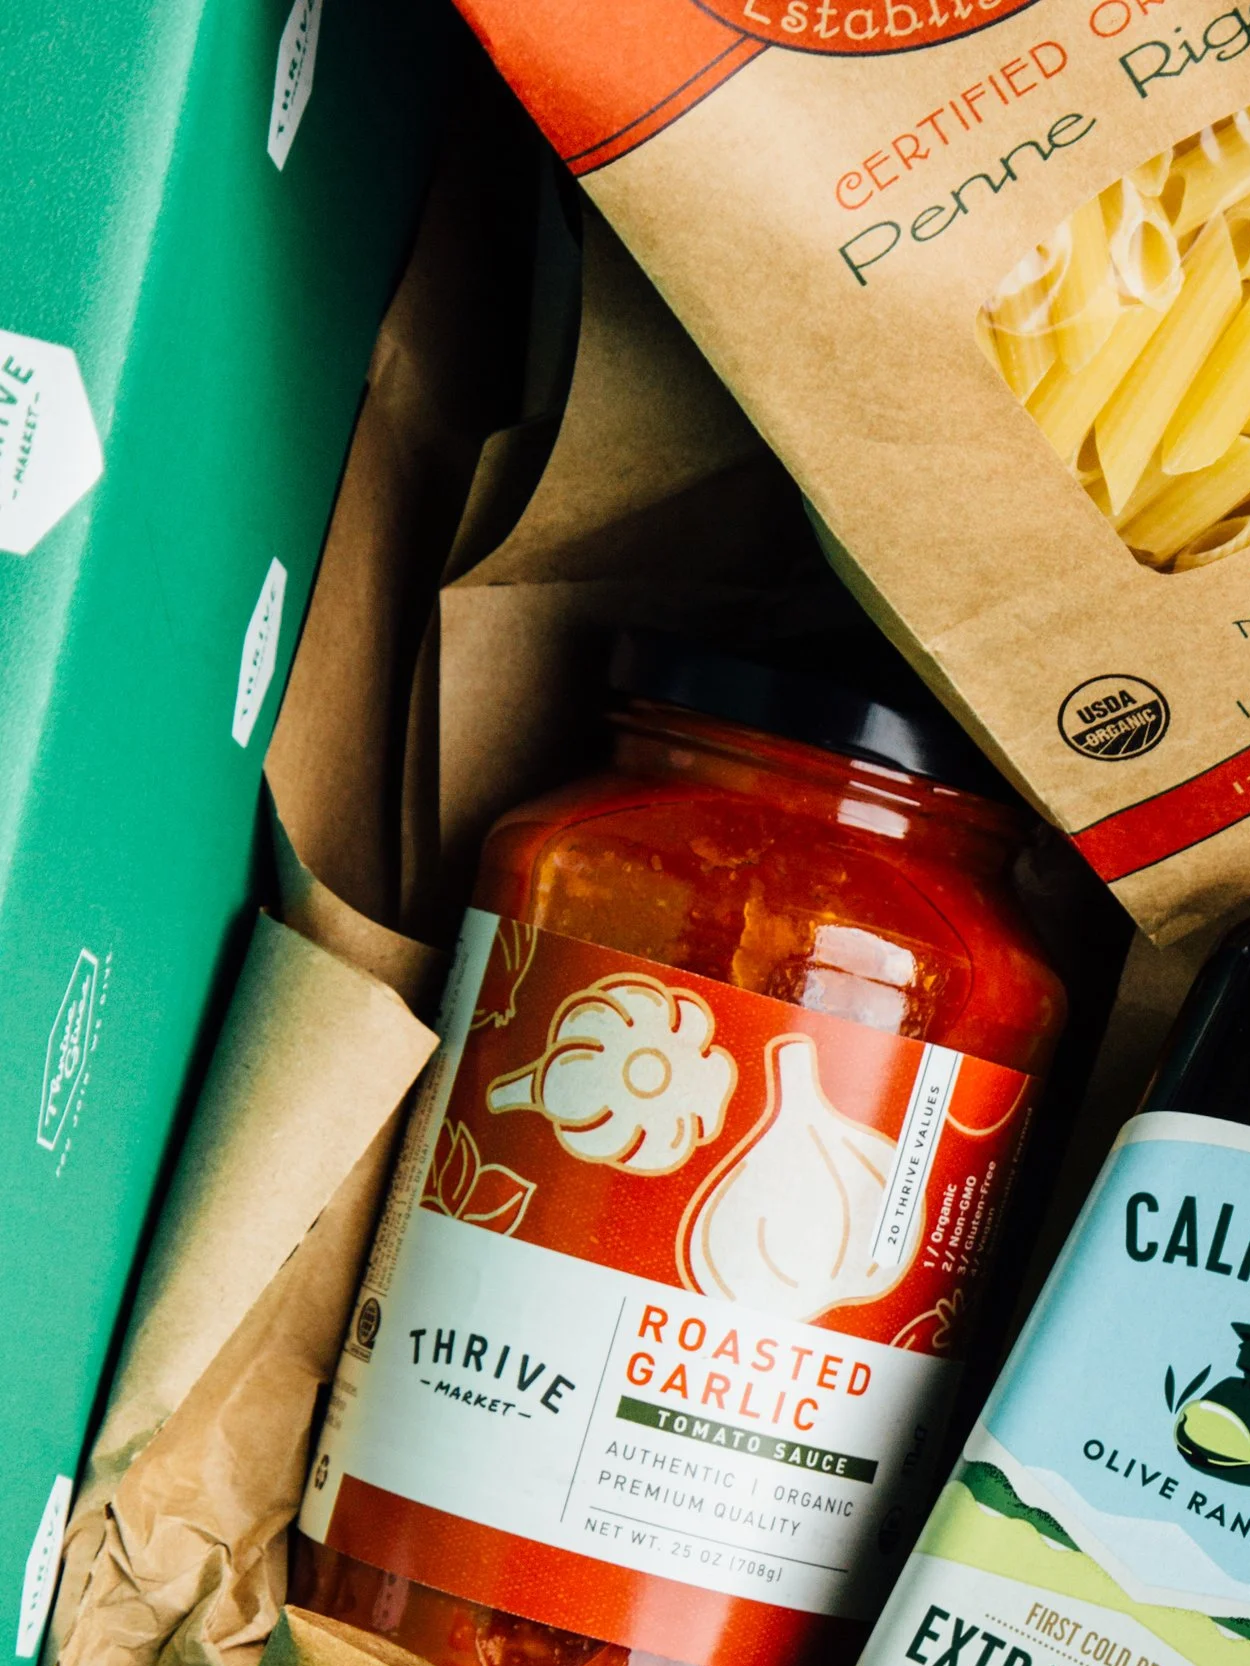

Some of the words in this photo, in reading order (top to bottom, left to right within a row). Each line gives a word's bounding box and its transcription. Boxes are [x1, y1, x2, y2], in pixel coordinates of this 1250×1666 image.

[837, 41, 1068, 209] CERTIFIED
[839, 113, 1096, 286] Penne
[1077, 691, 1137, 724] USDA
[1086, 709, 1156, 746] ORGANIC
[888, 1225, 900, 1244] 20
[896, 1158, 919, 1215] THRIVE
[915, 1087, 939, 1147] VALUES
[409, 1329, 575, 1413] THRIVE
[638, 1305, 871, 1396] ROASTED
[434, 1381, 515, 1415] MARKET
[627, 1352, 818, 1431] GARLIC
[659, 1411, 768, 1456] TOMATO
[772, 1439, 847, 1473] SAUCE
[1084, 1440, 1178, 1499] OLIVE
[598, 1471, 705, 1513] PREMIUM
[712, 1501, 801, 1537] QUALITY
[606, 1440, 736, 1488] AUTHENTIC
[773, 1484, 854, 1517] ORGANIC
[584, 1518, 622, 1540] NET
[629, 1530, 663, 1551] WT.
[670, 1541, 693, 1559] 25
[700, 1549, 722, 1567] OZ
[1026, 1603, 1082, 1646] FIRST
